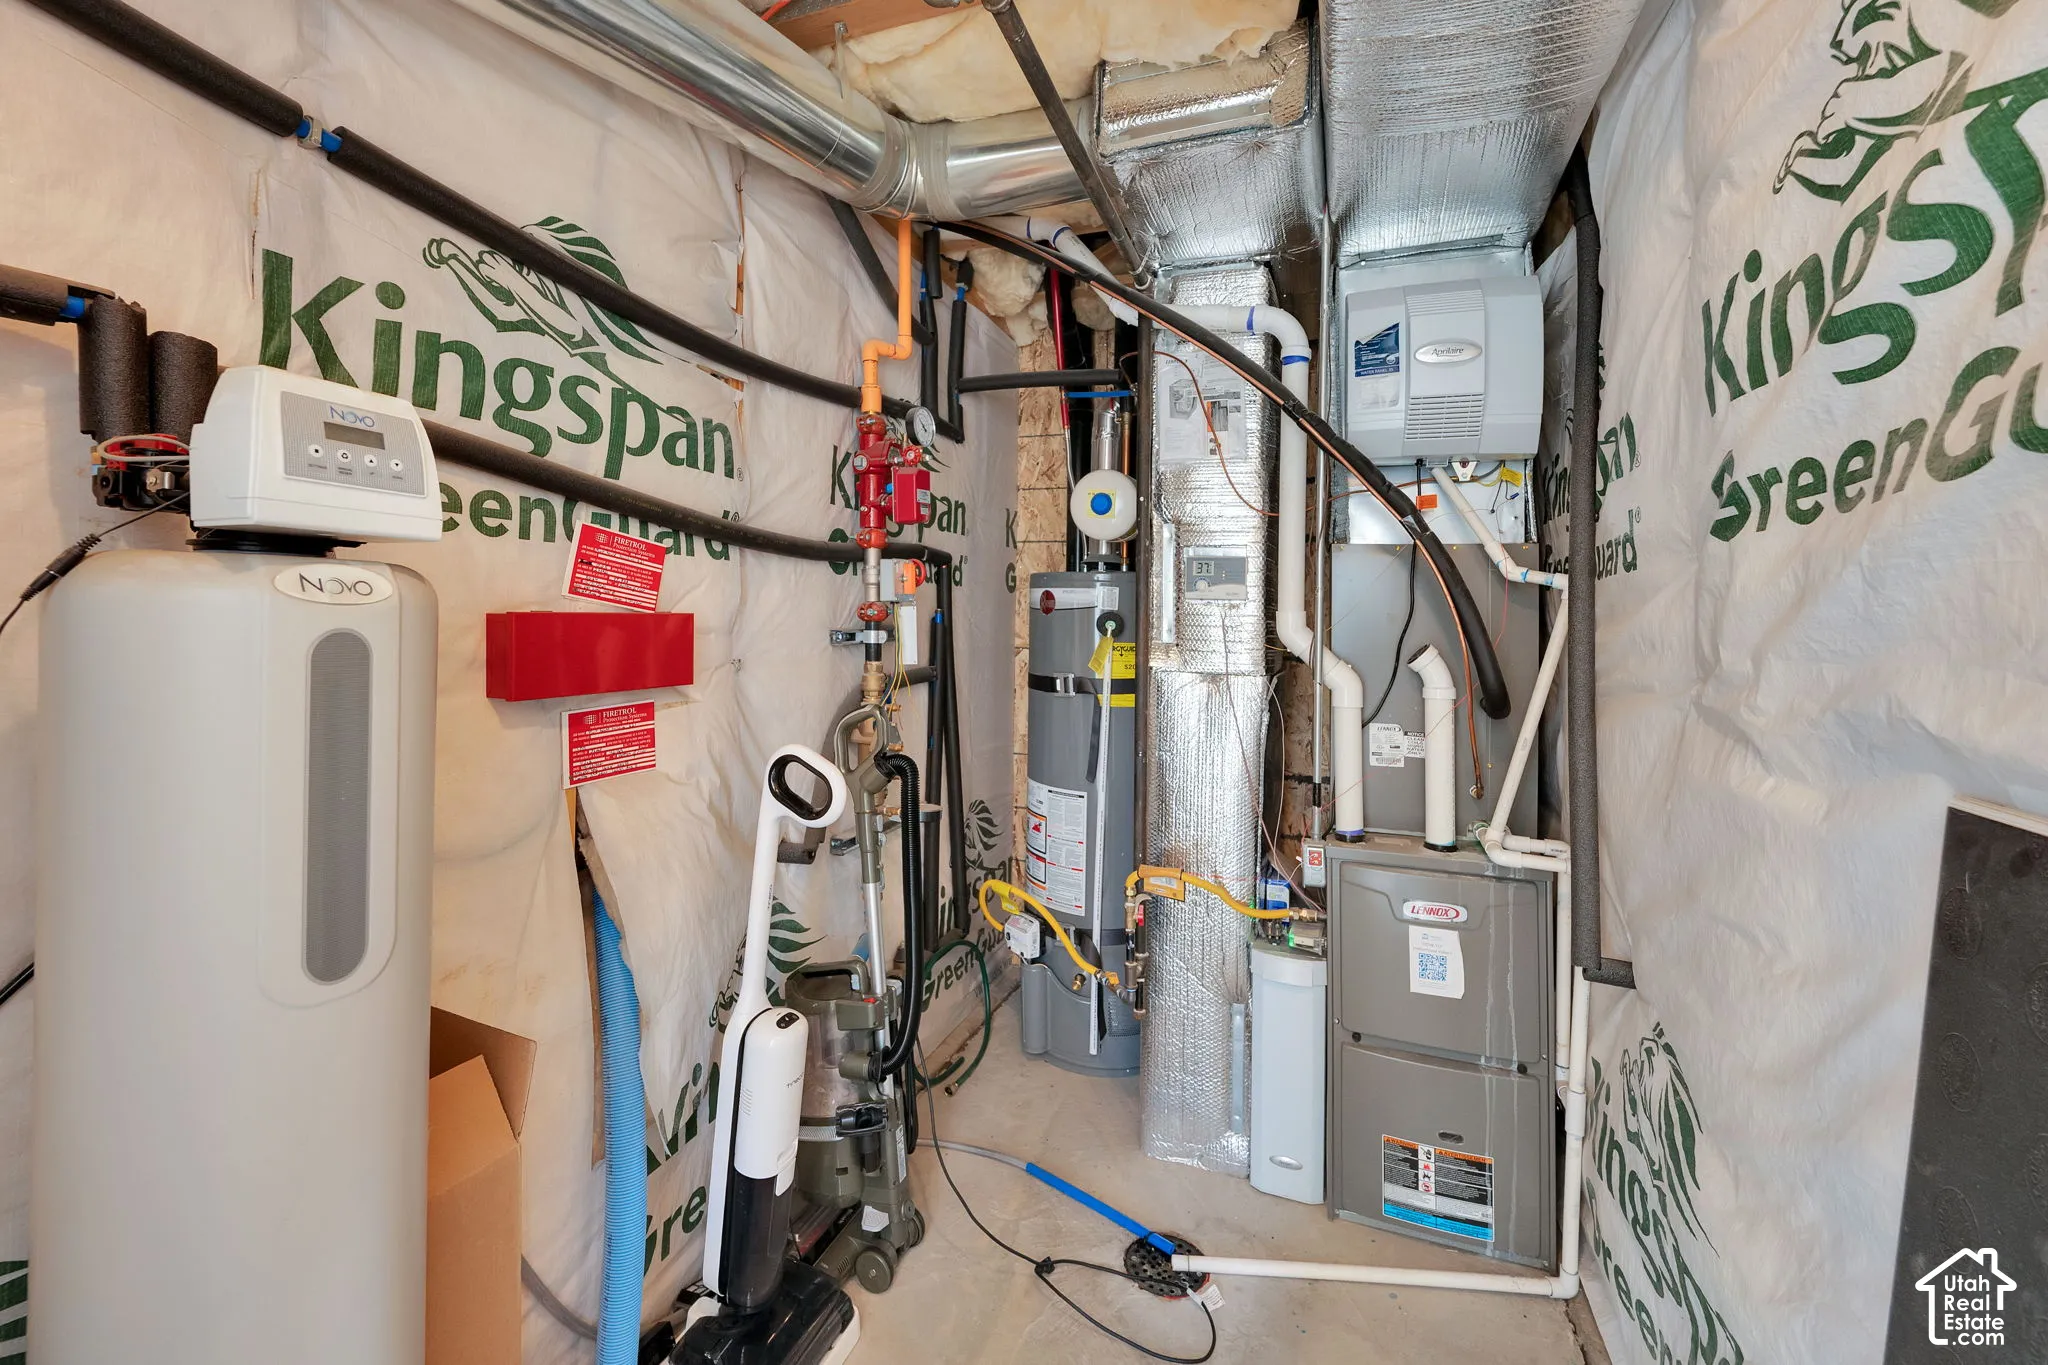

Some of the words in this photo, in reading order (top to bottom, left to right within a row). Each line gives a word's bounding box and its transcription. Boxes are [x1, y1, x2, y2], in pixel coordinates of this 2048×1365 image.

[1431, 347, 1464, 357] Aprilaire
[258, 248, 734, 480] Kingspan
[330, 406, 375, 428] NOVO
[613, 543, 637, 553] Protection
[638, 549, 656, 558] Systems
[614, 536, 647, 551] FIRETROL
[299, 573, 373, 596] NOVO
[602, 707, 637, 717] FIRETROL
[602, 715, 628, 723] Protection
[628, 712, 647, 720] Systems
[1411, 905, 1450, 917] LENNOX
